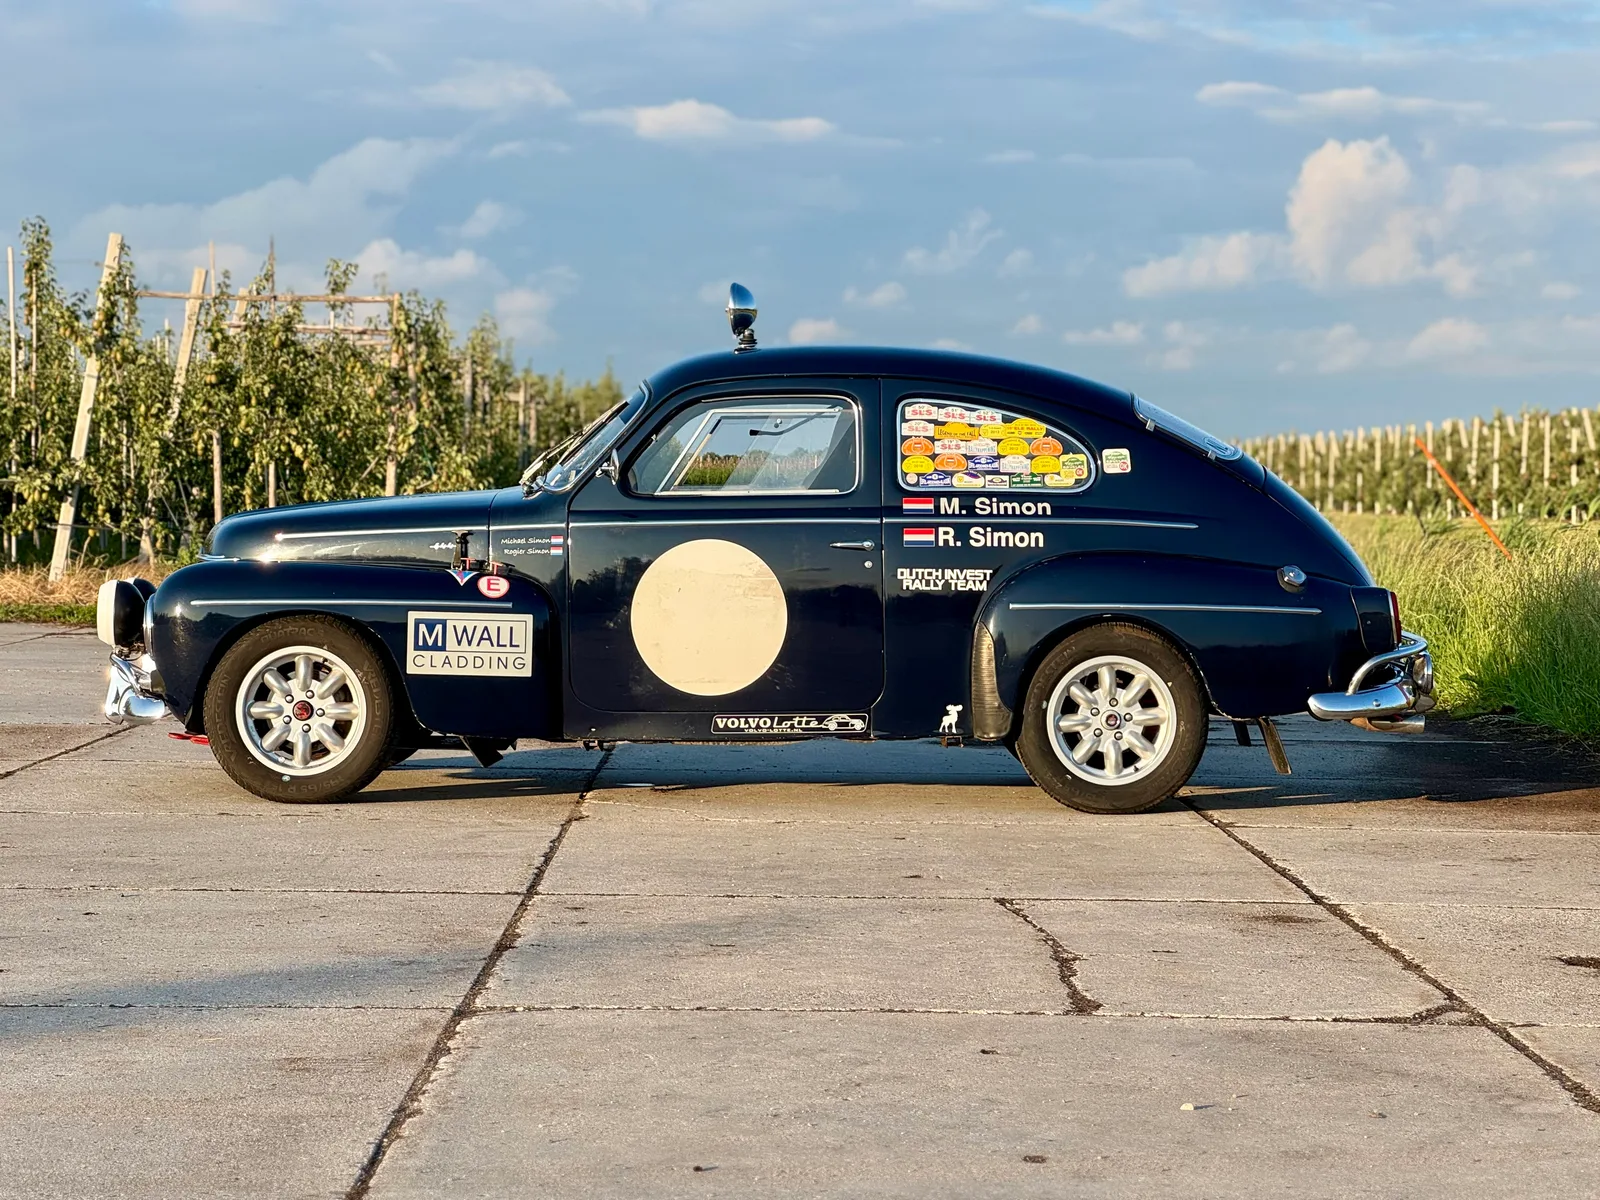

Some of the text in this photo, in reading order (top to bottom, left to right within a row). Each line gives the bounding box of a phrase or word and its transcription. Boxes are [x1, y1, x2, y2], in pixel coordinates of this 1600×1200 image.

[940, 497, 1052, 515] M. Simon
[938, 526, 1044, 548] R. Simon
[504, 548, 526, 556] Rogier
[896, 568, 992, 581] DUTCH INVEST
[486, 578, 500, 591] E
[902, 580, 988, 592] RALLY TEAM
[418, 624, 520, 648] M WALL
[412, 654, 526, 670] CLADDING
[217, 674, 236, 762] VREDESTEIN
[716, 716, 822, 729] VOLVO Lotte
